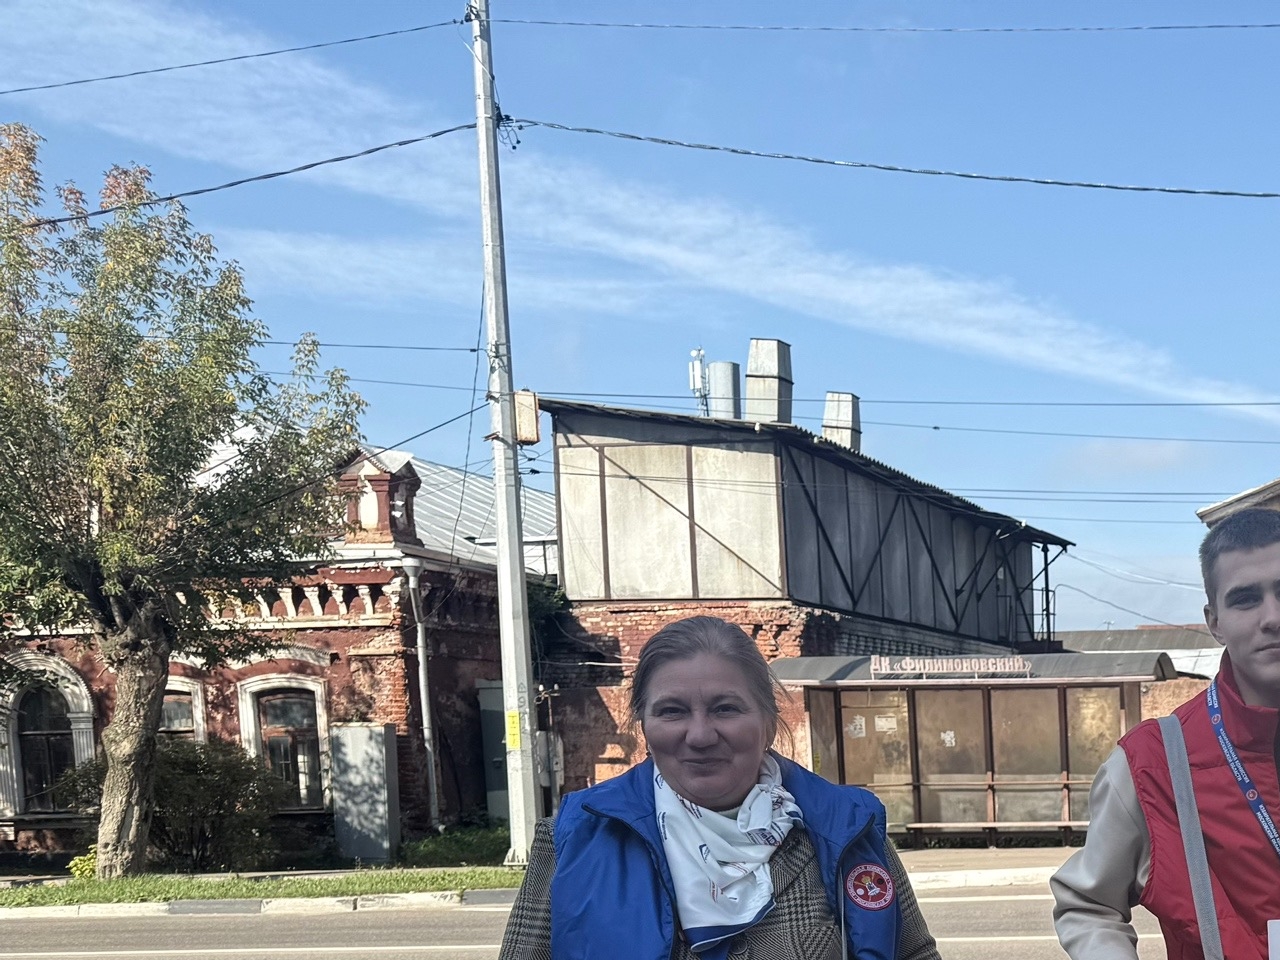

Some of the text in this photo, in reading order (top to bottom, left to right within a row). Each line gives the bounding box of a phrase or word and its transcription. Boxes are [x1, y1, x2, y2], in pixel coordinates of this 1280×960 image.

[870, 655, 890, 673] ДК
[1218, 735, 1242, 782] МОСКОВСКОЙ ОБЛАСТИ
[1235, 760, 1250, 783] КОМИССИЯ
[1256, 811, 1274, 839] МОСКОВСКОЙ
[1259, 804, 1279, 838] ИЗБИРАТЕЛЬНАЯ
